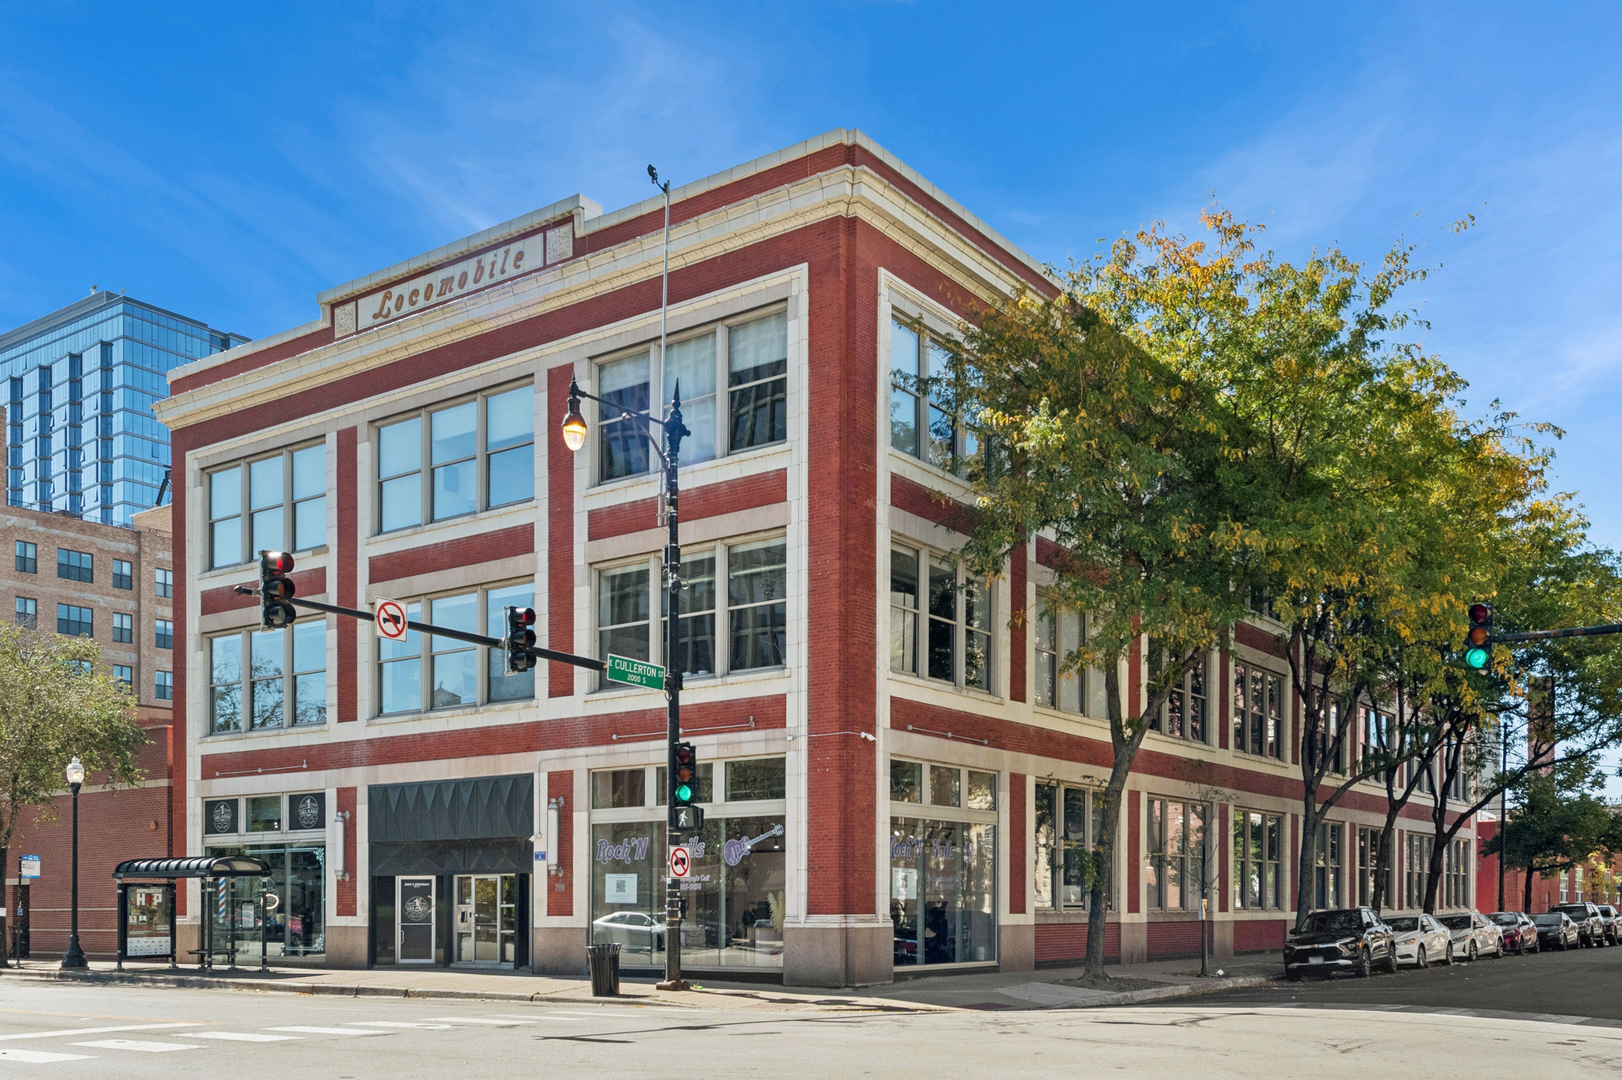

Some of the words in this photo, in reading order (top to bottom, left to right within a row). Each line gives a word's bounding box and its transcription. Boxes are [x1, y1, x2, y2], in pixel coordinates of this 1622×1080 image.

[372, 248, 525, 320] Locomobile
[609, 659, 613, 667] E
[615, 659, 657, 678] CULLERTON
[657, 670, 664, 679] ST
[627, 673, 641, 683] 2000
[596, 837, 649, 865] Rock'N
